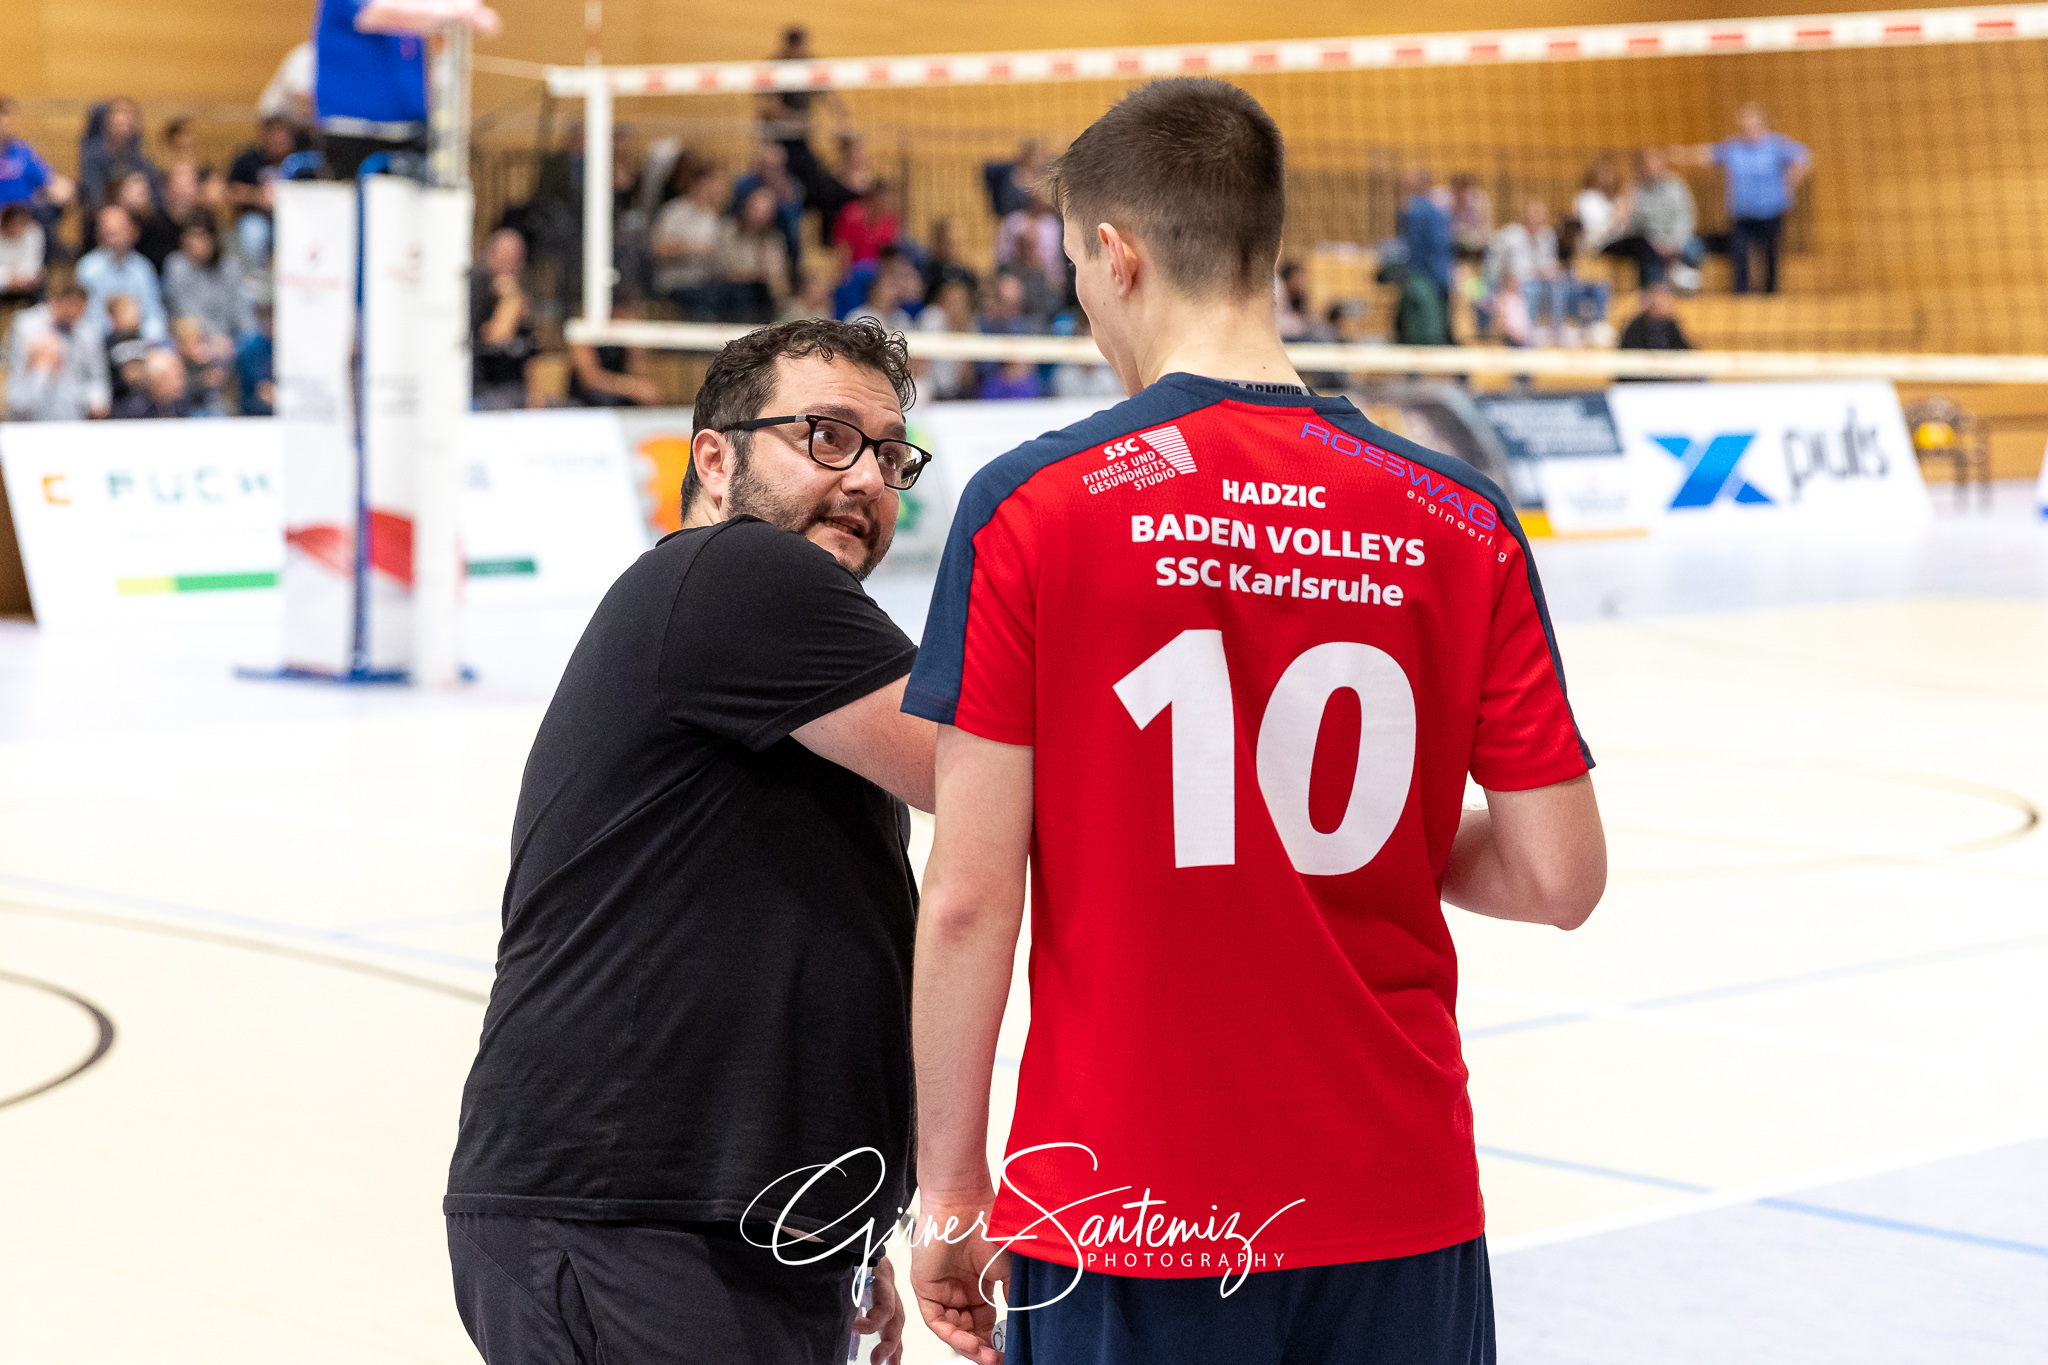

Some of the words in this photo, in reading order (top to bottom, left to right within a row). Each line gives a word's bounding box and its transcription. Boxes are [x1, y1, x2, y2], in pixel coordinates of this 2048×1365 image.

[1082, 460, 1129, 485] FITNESS
[1131, 450, 1156, 467] UND
[1103, 438, 1140, 461] SSC
[1782, 404, 1889, 501] puls
[1088, 459, 1167, 495] GESUNDHEITS
[1133, 468, 1176, 491] STUDIO
[1223, 479, 1326, 508] HADZIC
[1301, 423, 1496, 530] ROSSWAG
[1132, 515, 1256, 549] BADEN
[1266, 526, 1425, 567] VOLLEYS
[1406, 489, 1507, 562] engineerig
[1156, 557, 1222, 587] SSC
[1230, 564, 1404, 606] Karlsruhe
[1112, 629, 1417, 876] 10
